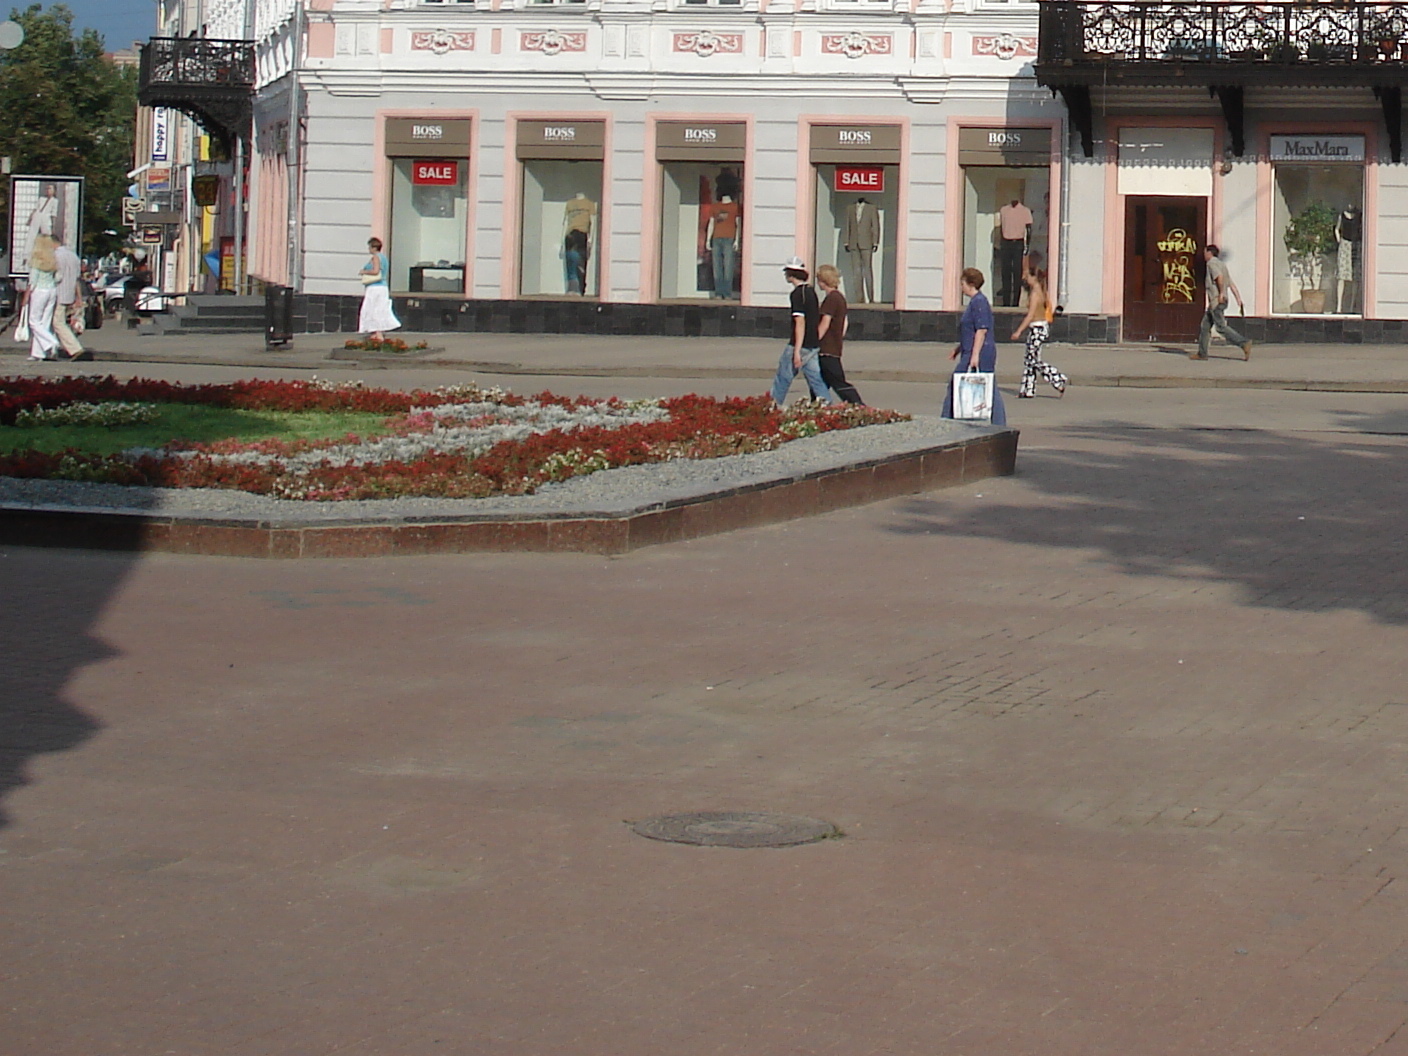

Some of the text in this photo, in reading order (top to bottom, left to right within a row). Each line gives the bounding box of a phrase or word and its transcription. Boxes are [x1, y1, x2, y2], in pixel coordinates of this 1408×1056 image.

[412, 125, 443, 135] BOSS
[544, 127, 575, 137] BOSS
[685, 128, 716, 139] BOSS
[839, 130, 871, 141] BOSS
[988, 132, 1021, 143] BOSS
[1284, 141, 1349, 157] MaxMara
[418, 166, 452, 179] SALE
[841, 172, 878, 185] SALE
